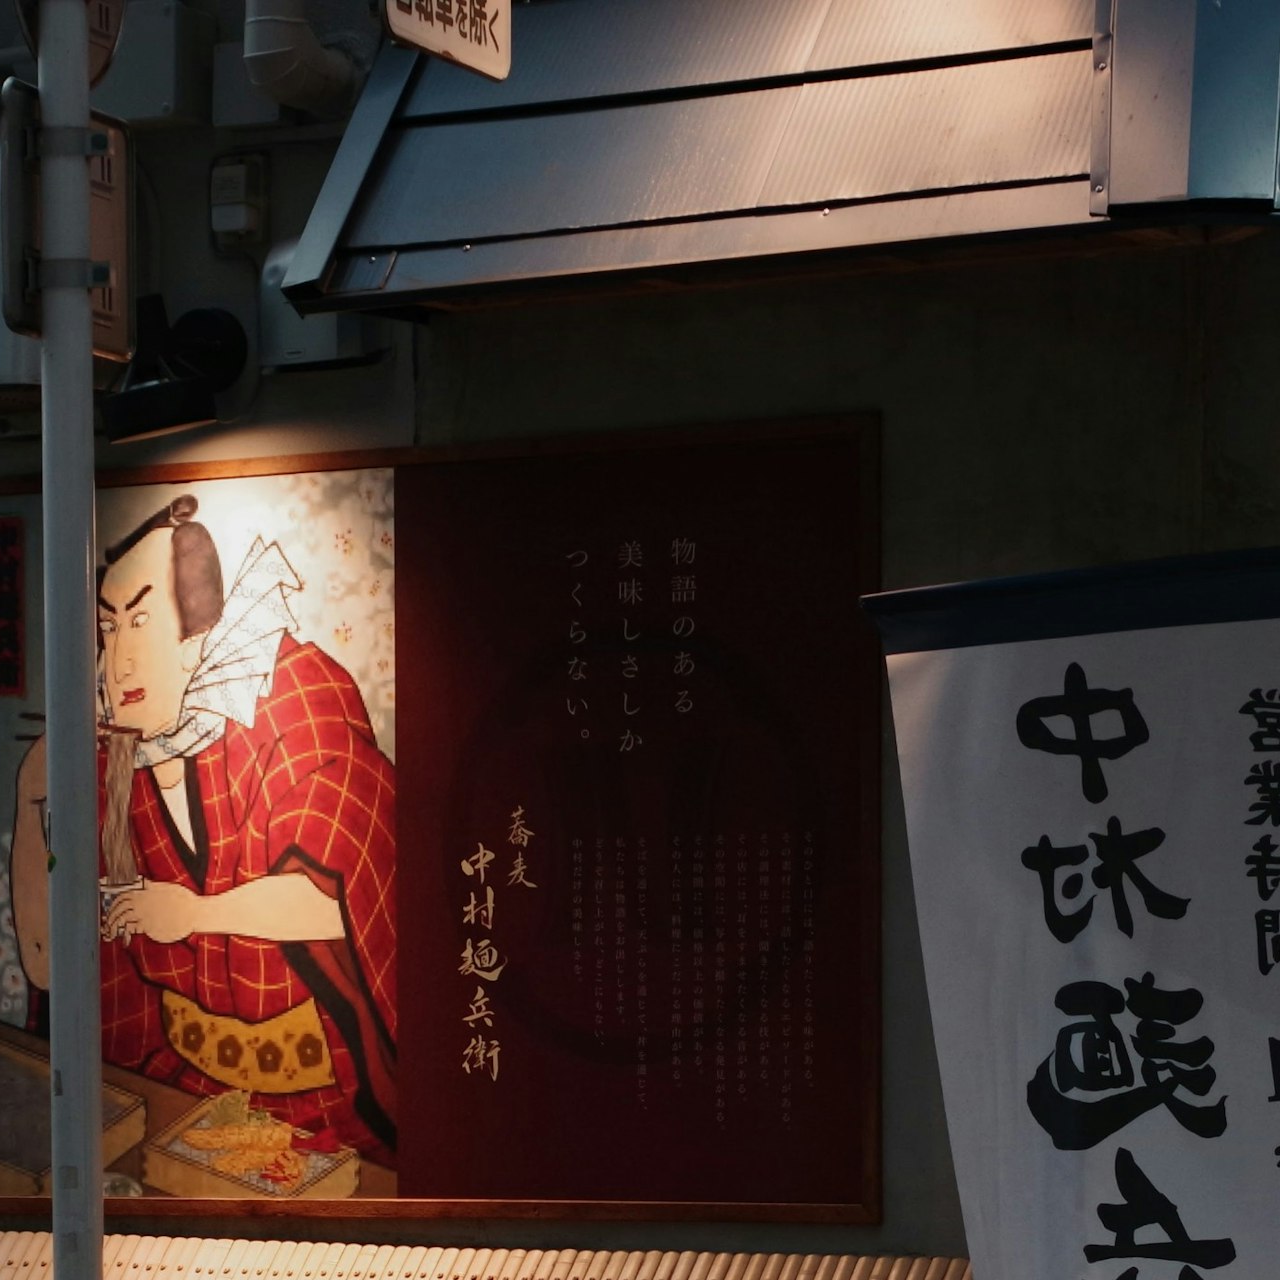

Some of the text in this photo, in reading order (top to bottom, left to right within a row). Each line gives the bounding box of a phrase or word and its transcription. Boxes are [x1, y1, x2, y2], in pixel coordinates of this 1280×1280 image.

[565, 550, 591, 738] つくらない。
[618, 540, 644, 752] 美味しさしか
[671, 537, 697, 713] 物語のある
[506, 805, 539, 889] 蕎麦
